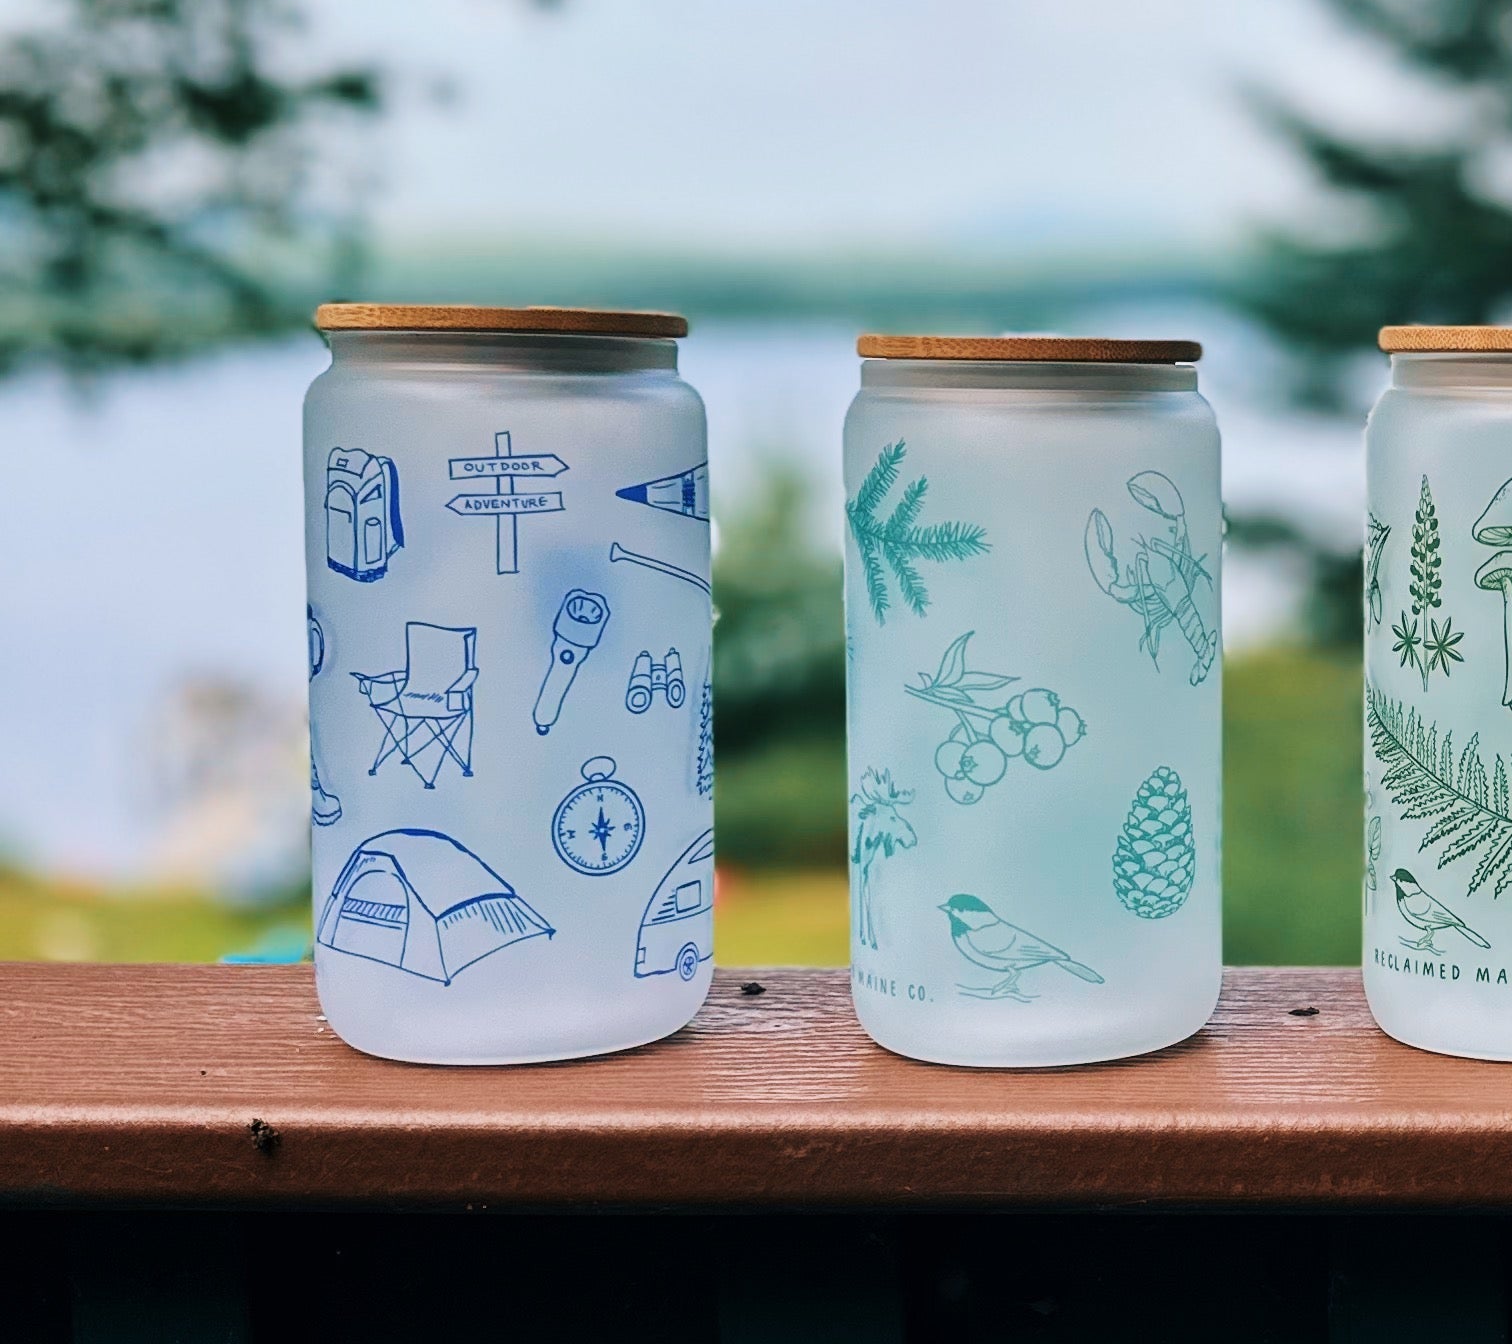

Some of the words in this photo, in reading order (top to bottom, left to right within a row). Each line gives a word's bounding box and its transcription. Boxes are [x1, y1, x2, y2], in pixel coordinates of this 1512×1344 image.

[463, 460, 544, 473] OUTDOOR
[464, 496, 549, 510] ADVENTURE
[1374, 948, 1460, 980] RECLAIMED
[907, 983, 934, 1003] CO.
